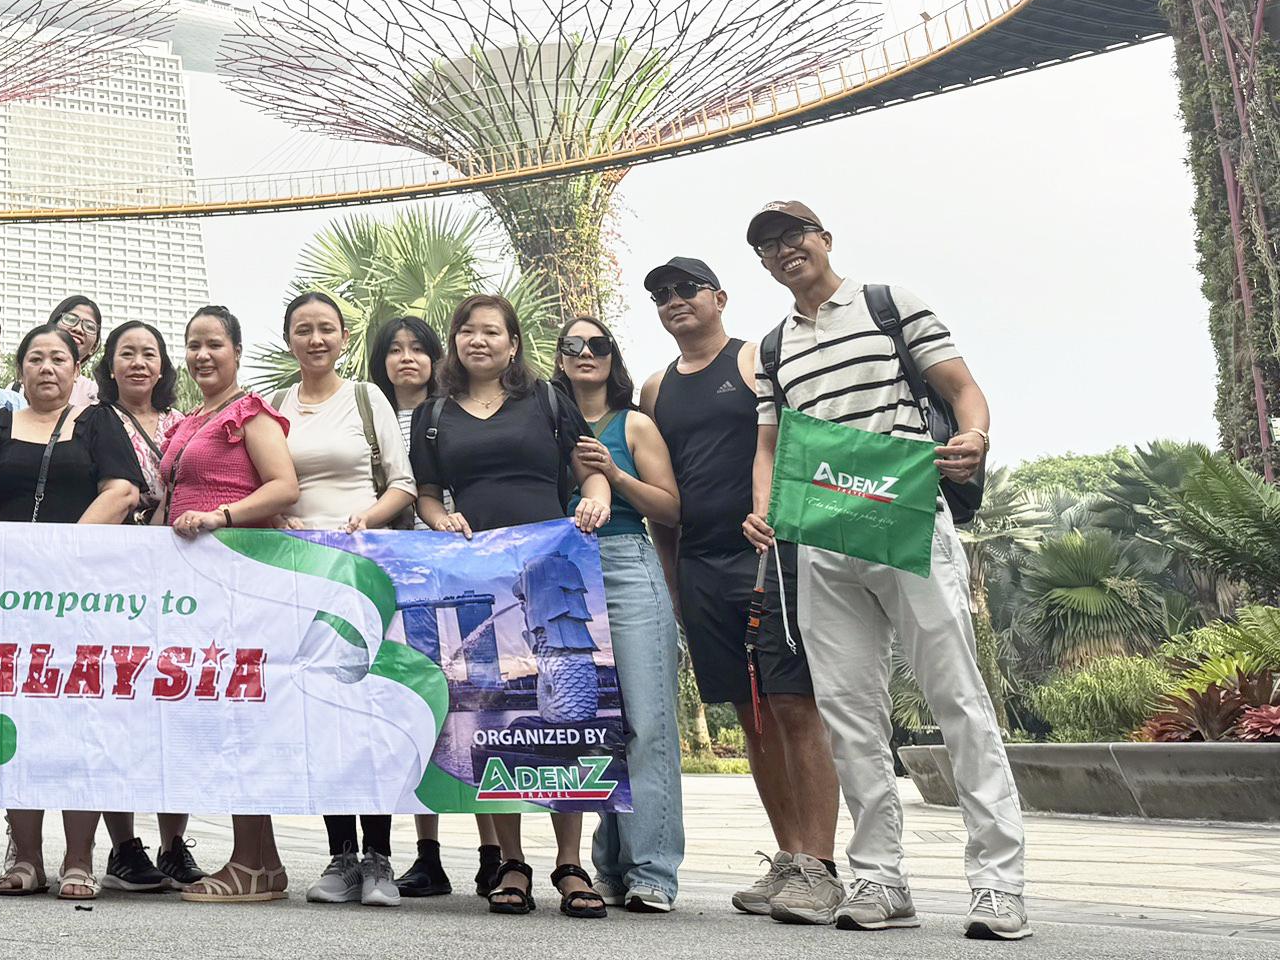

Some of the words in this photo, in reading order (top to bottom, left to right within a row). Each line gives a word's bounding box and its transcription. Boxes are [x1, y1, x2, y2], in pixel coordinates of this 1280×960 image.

[161, 589, 198, 616] to
[473, 728, 581, 745] ORGANIZED
[584, 728, 608, 744] BY
[519, 791, 571, 799] TRAVEL
